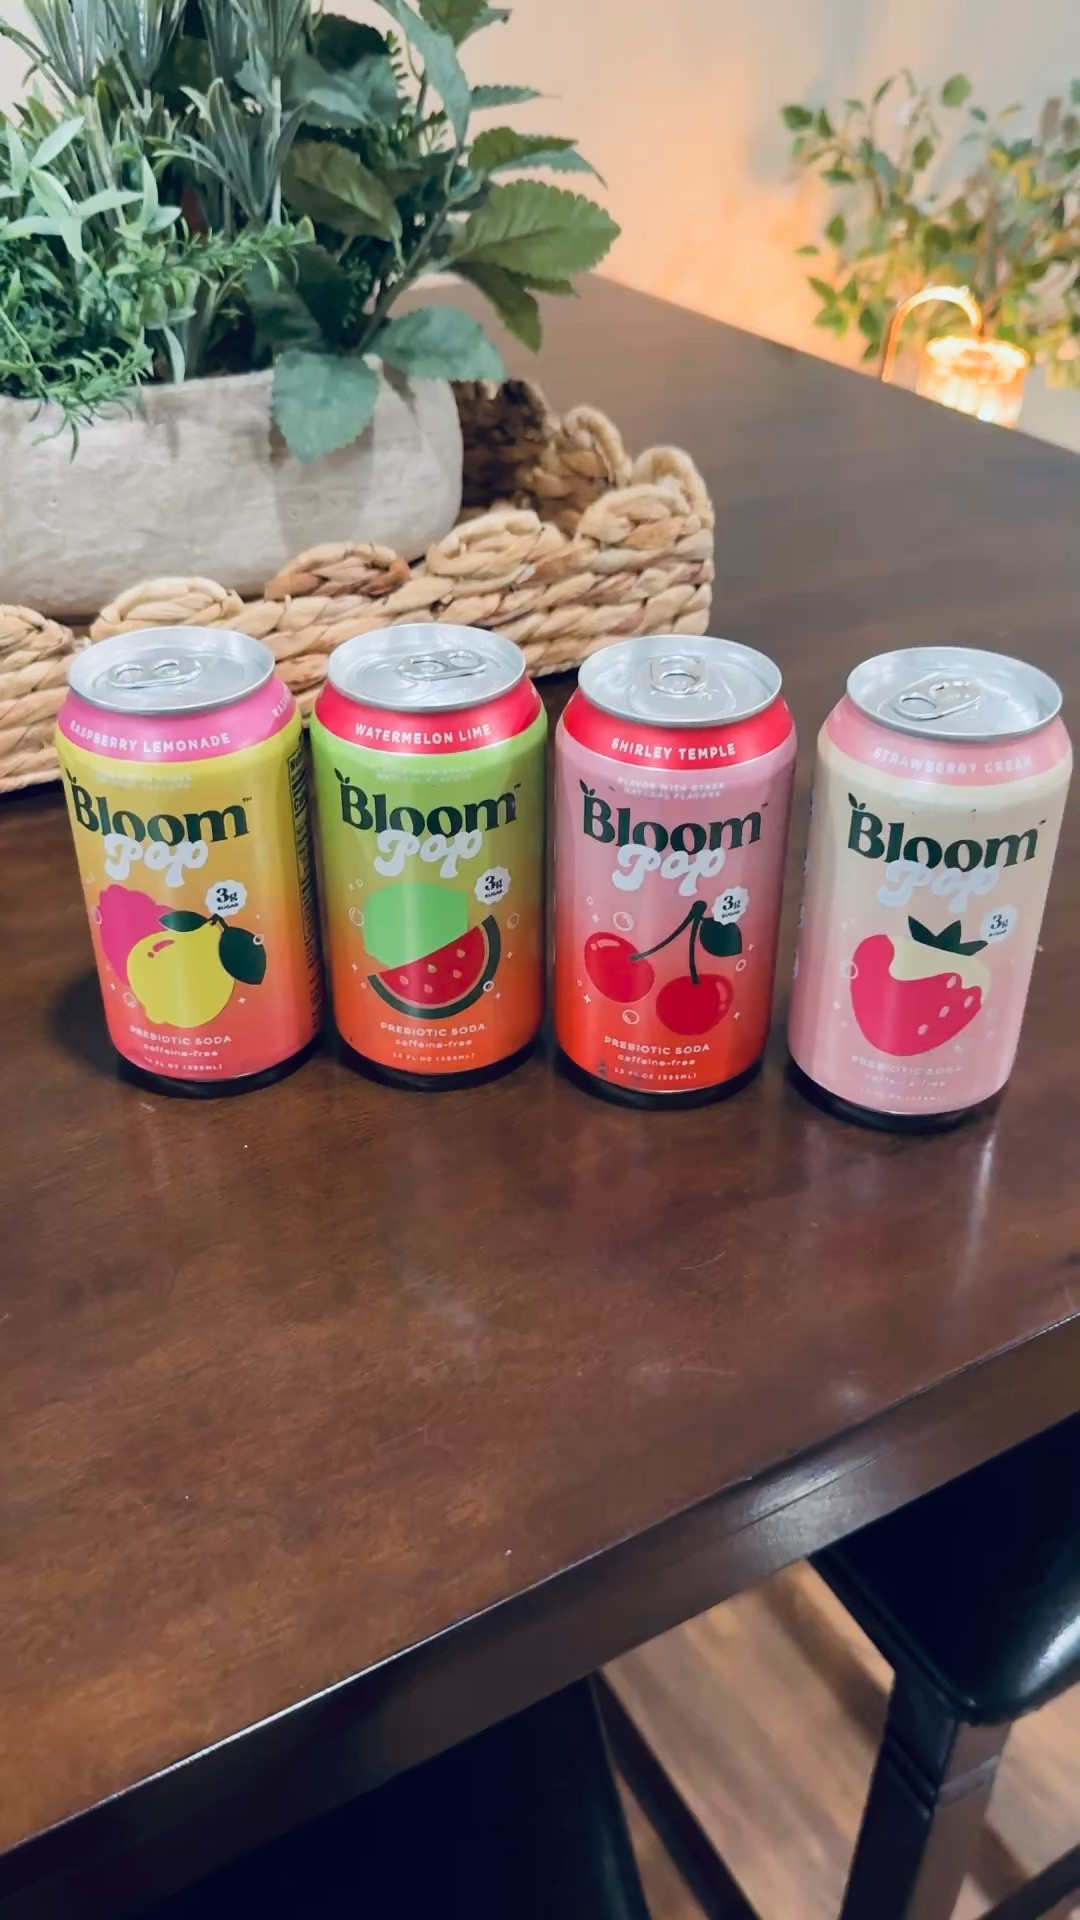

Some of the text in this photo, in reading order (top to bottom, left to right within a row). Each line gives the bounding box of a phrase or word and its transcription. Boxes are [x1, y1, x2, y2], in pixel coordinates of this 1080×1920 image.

[70, 720, 230, 753] RASPBERRY LEMONADE
[355, 722, 492, 745] WATERMELON LIME
[611, 738, 737, 760] SHIRLEY TEMPLE
[872, 747, 977, 775] STRAWBERRY
[69, 773, 249, 846] Bloom
[337, 777, 517, 839] Bloom
[581, 788, 762, 855] Bloom
[847, 801, 1039, 873] Bloom
[104, 833, 208, 888] Pop
[373, 830, 483, 878] Pop
[612, 844, 726, 896] Pop
[216, 887, 238, 902] 3g
[485, 875, 503, 891] 3g
[876, 860, 998, 914] Pop
[129, 1024, 232, 1046] PREBIOTIC SODA
[380, 1021, 486, 1037] PREBIOTIC SODA
[143, 1043, 219, 1057] caffeine-free
[395, 1039, 473, 1049] caffeine-free
[604, 1036, 710, 1055] PREBIOTIC SODA
[617, 1053, 696, 1067] caffeine-free
